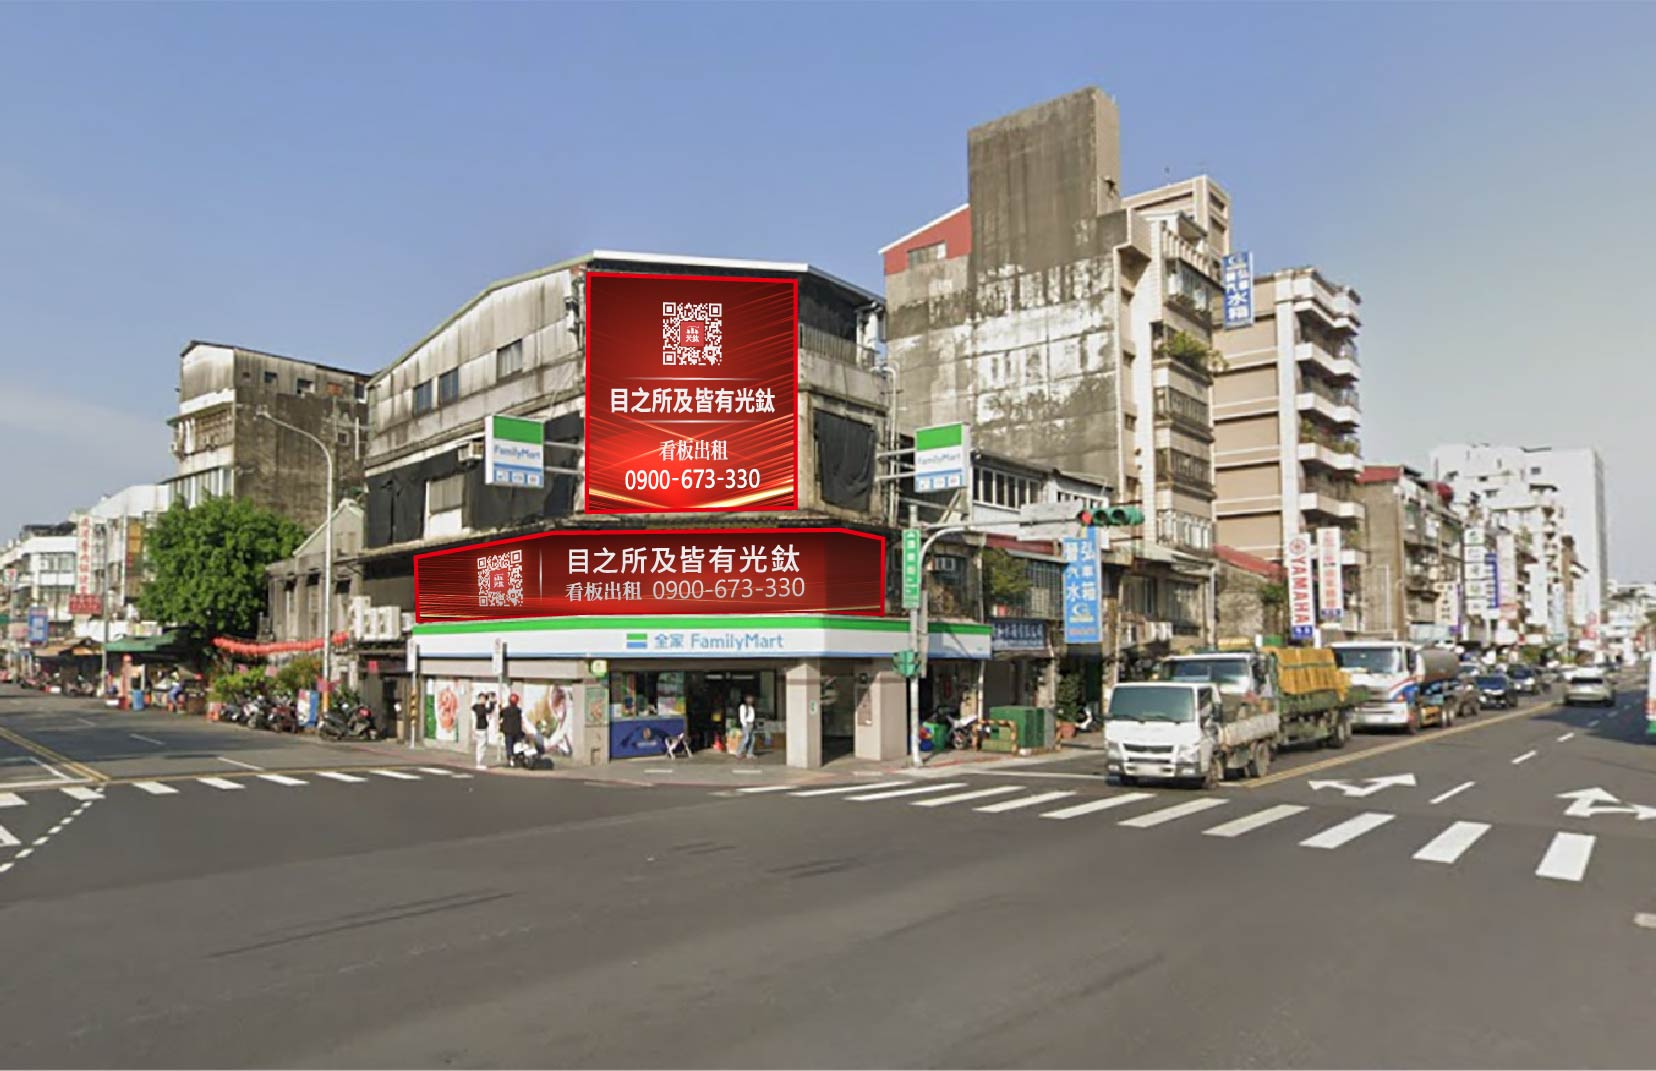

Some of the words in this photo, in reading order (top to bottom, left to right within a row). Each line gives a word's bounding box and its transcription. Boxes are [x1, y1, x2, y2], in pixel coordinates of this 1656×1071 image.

[610, 387, 776, 414] 目之所及皆有光鈦
[659, 440, 728, 461] 看板出租
[624, 469, 761, 490] 0900-673-330
[567, 544, 801, 575] 目之所及皆有光鈦
[565, 580, 643, 602] 看板出租
[652, 577, 806, 600] 0900-673-330
[654, 633, 684, 649] 全家
[690, 633, 785, 651] FamilyMart
